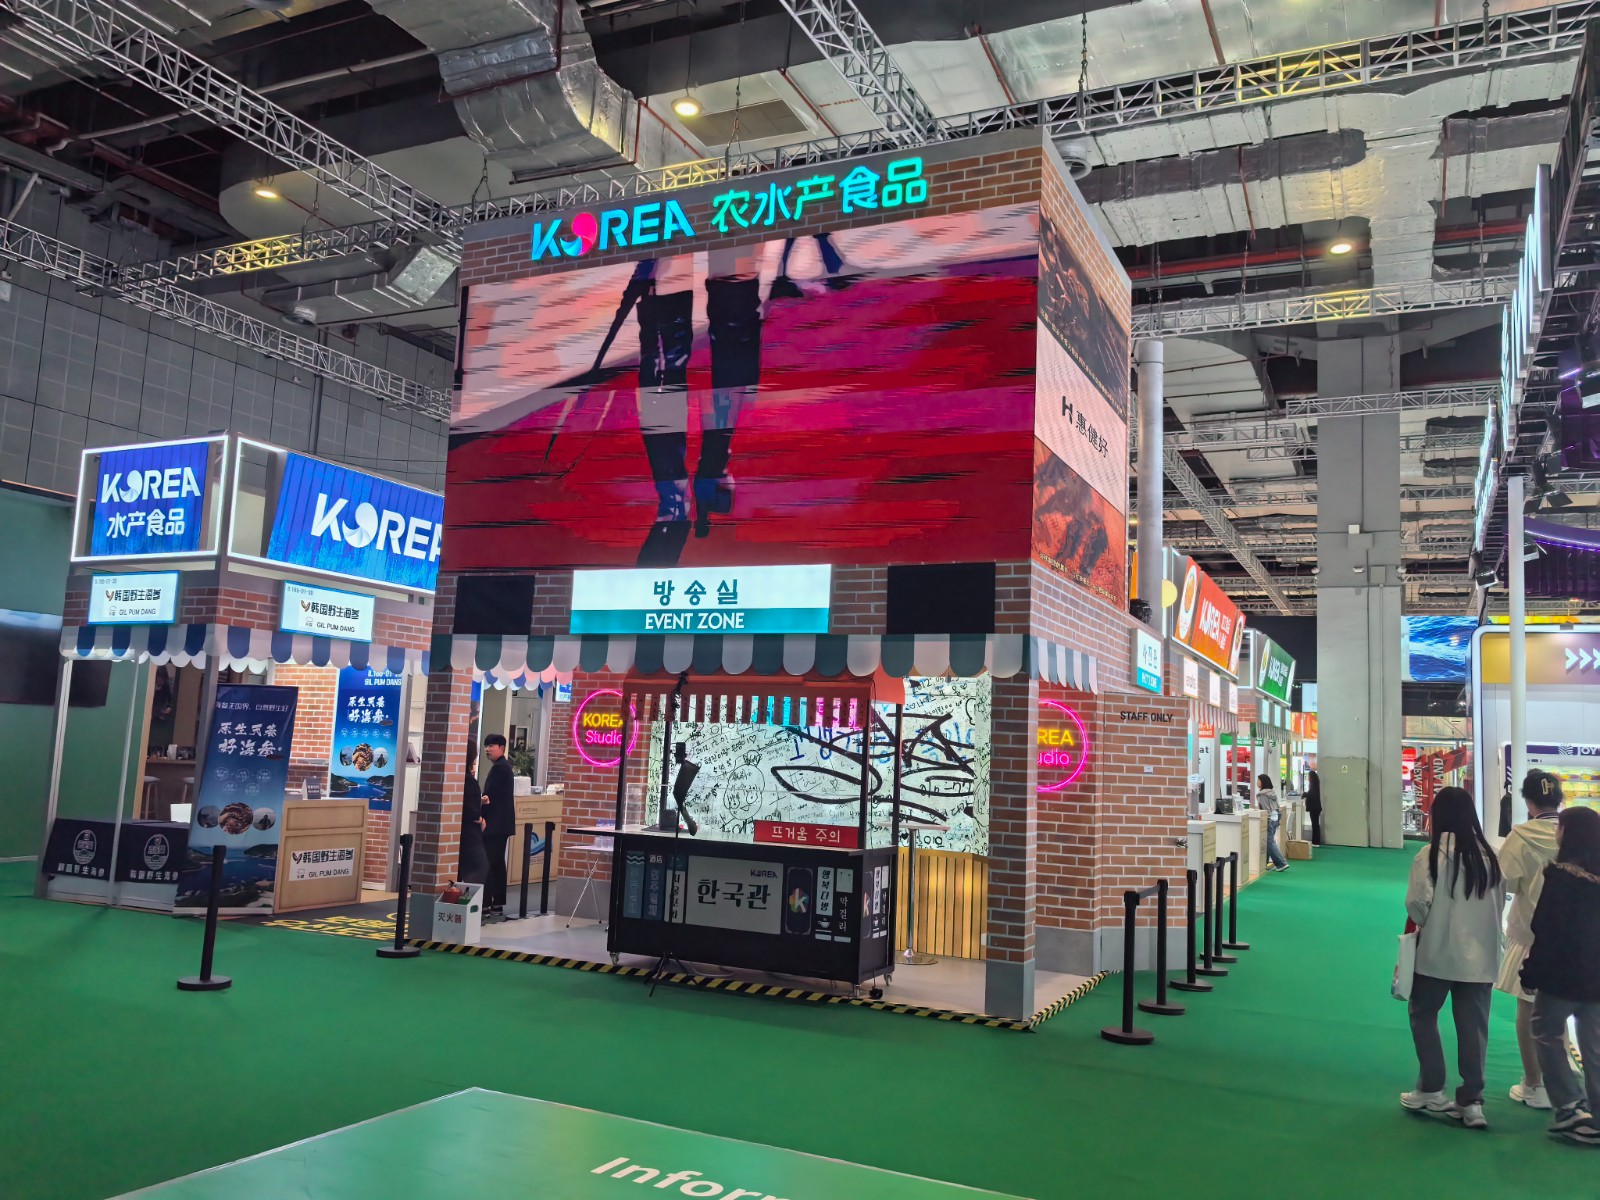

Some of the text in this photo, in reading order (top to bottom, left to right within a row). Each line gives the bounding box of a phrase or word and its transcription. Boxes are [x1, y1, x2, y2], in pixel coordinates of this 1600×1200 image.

[531, 157, 928, 261] KOREA 农水产食品
[101, 467, 200, 504] KOREA
[106, 508, 185, 539] 水产食品
[654, 579, 738, 606] 방송실
[645, 612, 745, 630] EVENT ZONE
[1120, 711, 1173, 723] STAFF ONLY
[1037, 729, 1074, 746] REA
[1577, 746, 1600, 755] JOY
[1433, 758, 1444, 799] ALAND
[771, 826, 840, 843] 뜨거움 주의
[333, 868, 349, 876] DANG
[751, 869, 777, 879] KOREA
[697, 879, 772, 911] 한국관
[590, 1157, 790, 1200] Infor
